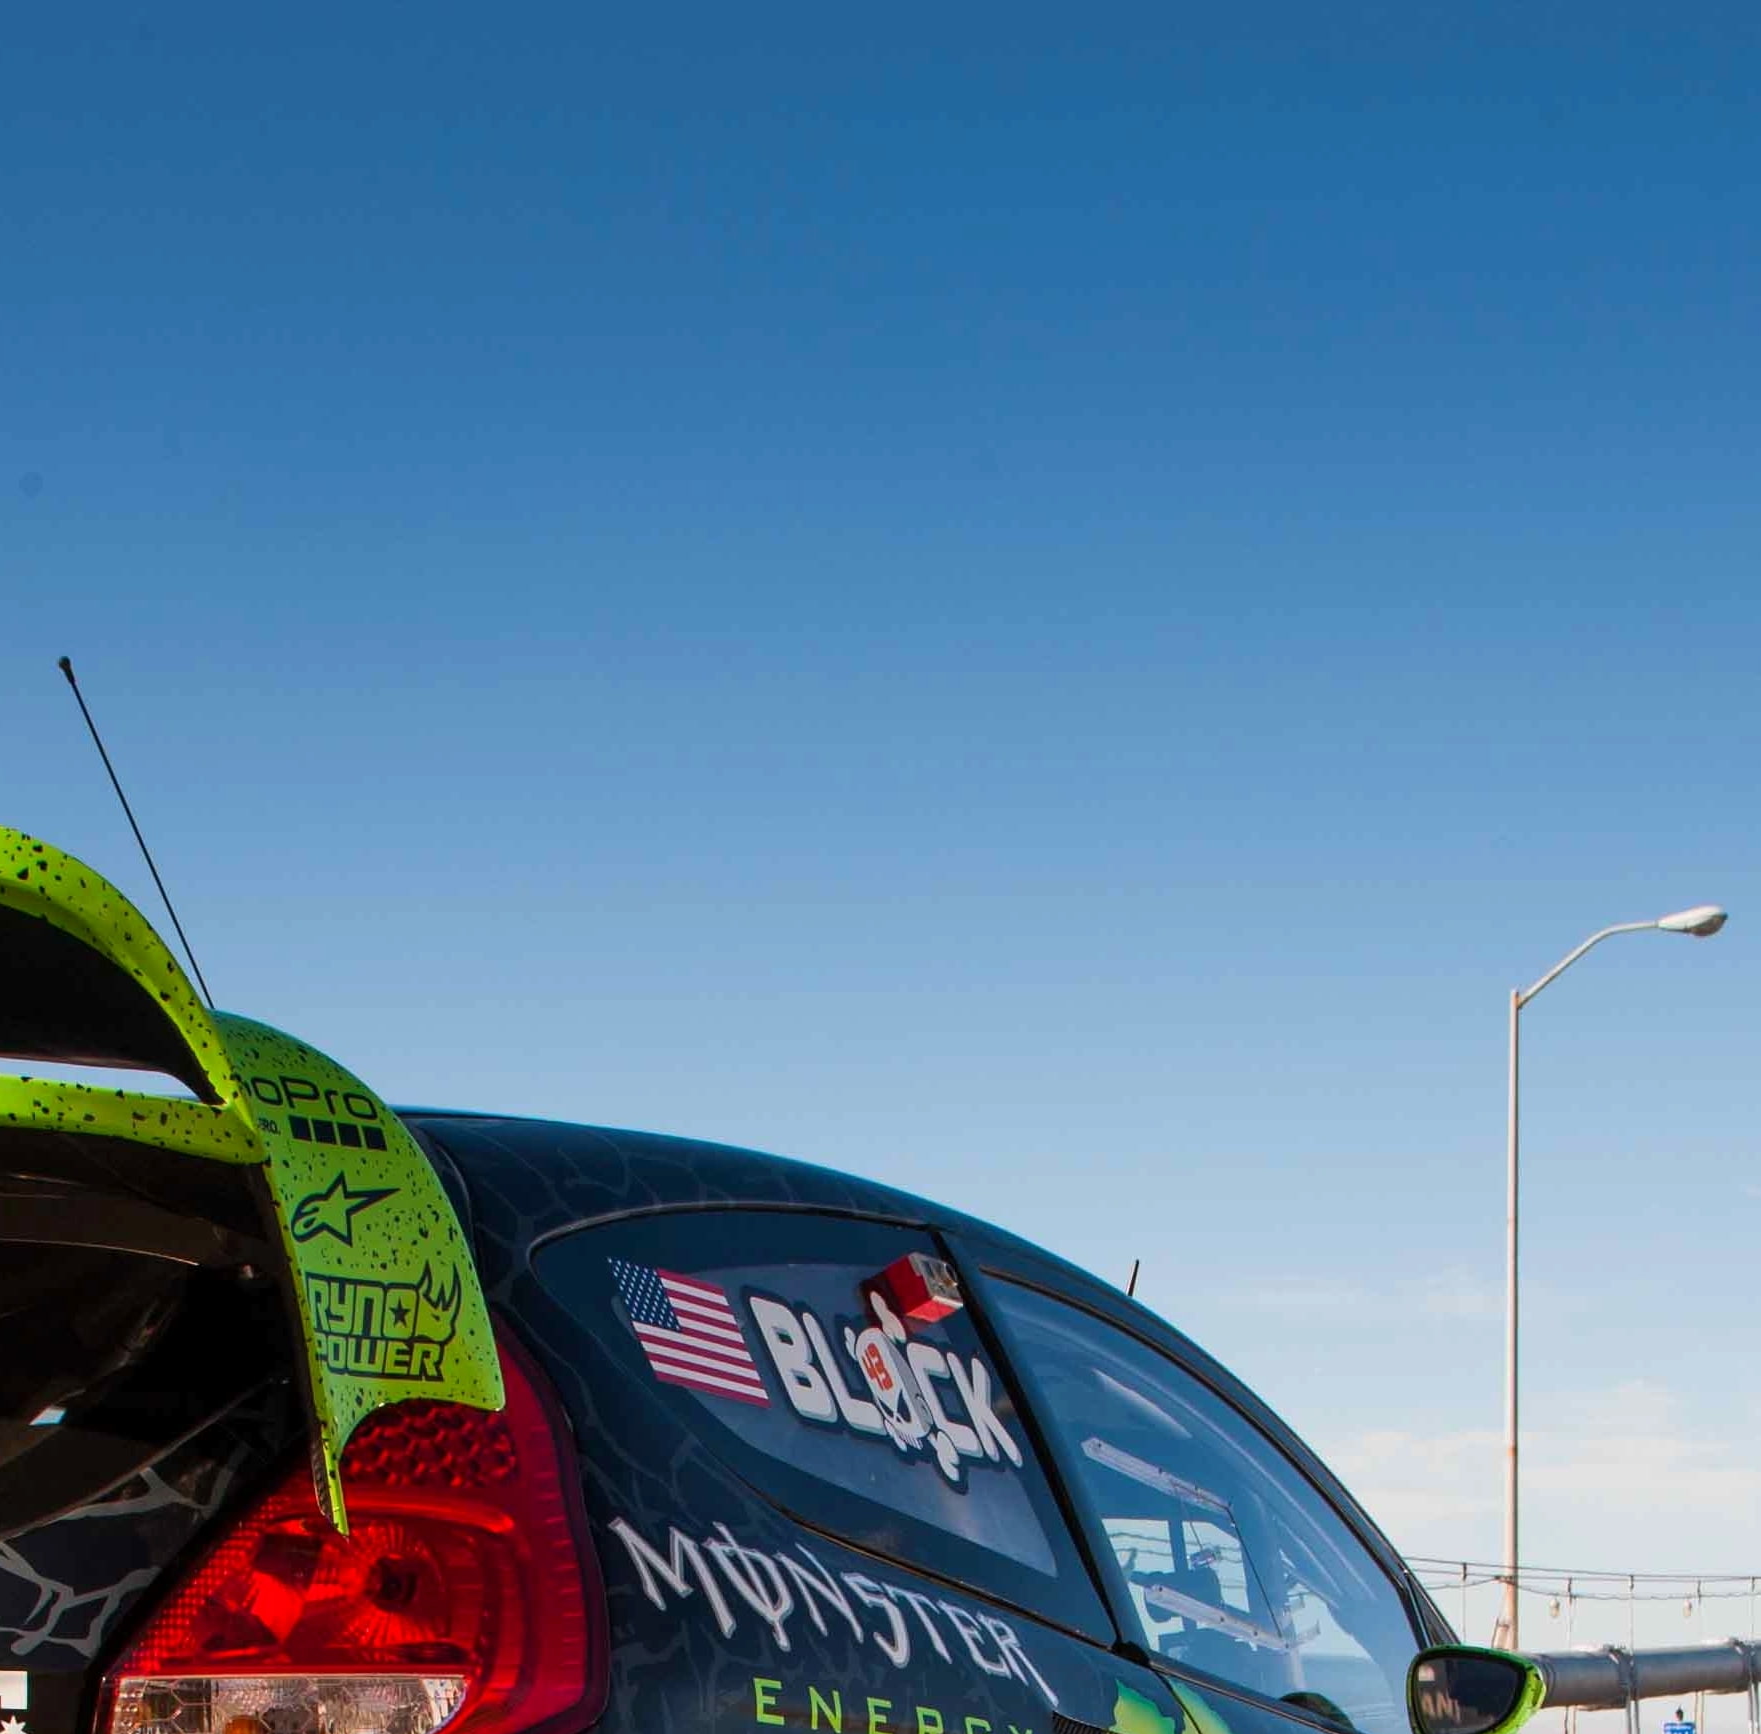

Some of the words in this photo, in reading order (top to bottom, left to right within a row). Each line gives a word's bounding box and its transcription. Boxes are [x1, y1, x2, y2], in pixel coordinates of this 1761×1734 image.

[242, 1074, 378, 1120] oPro
[315, 1336, 444, 1382] POWER
[607, 1515, 1059, 1707] MONSTER
